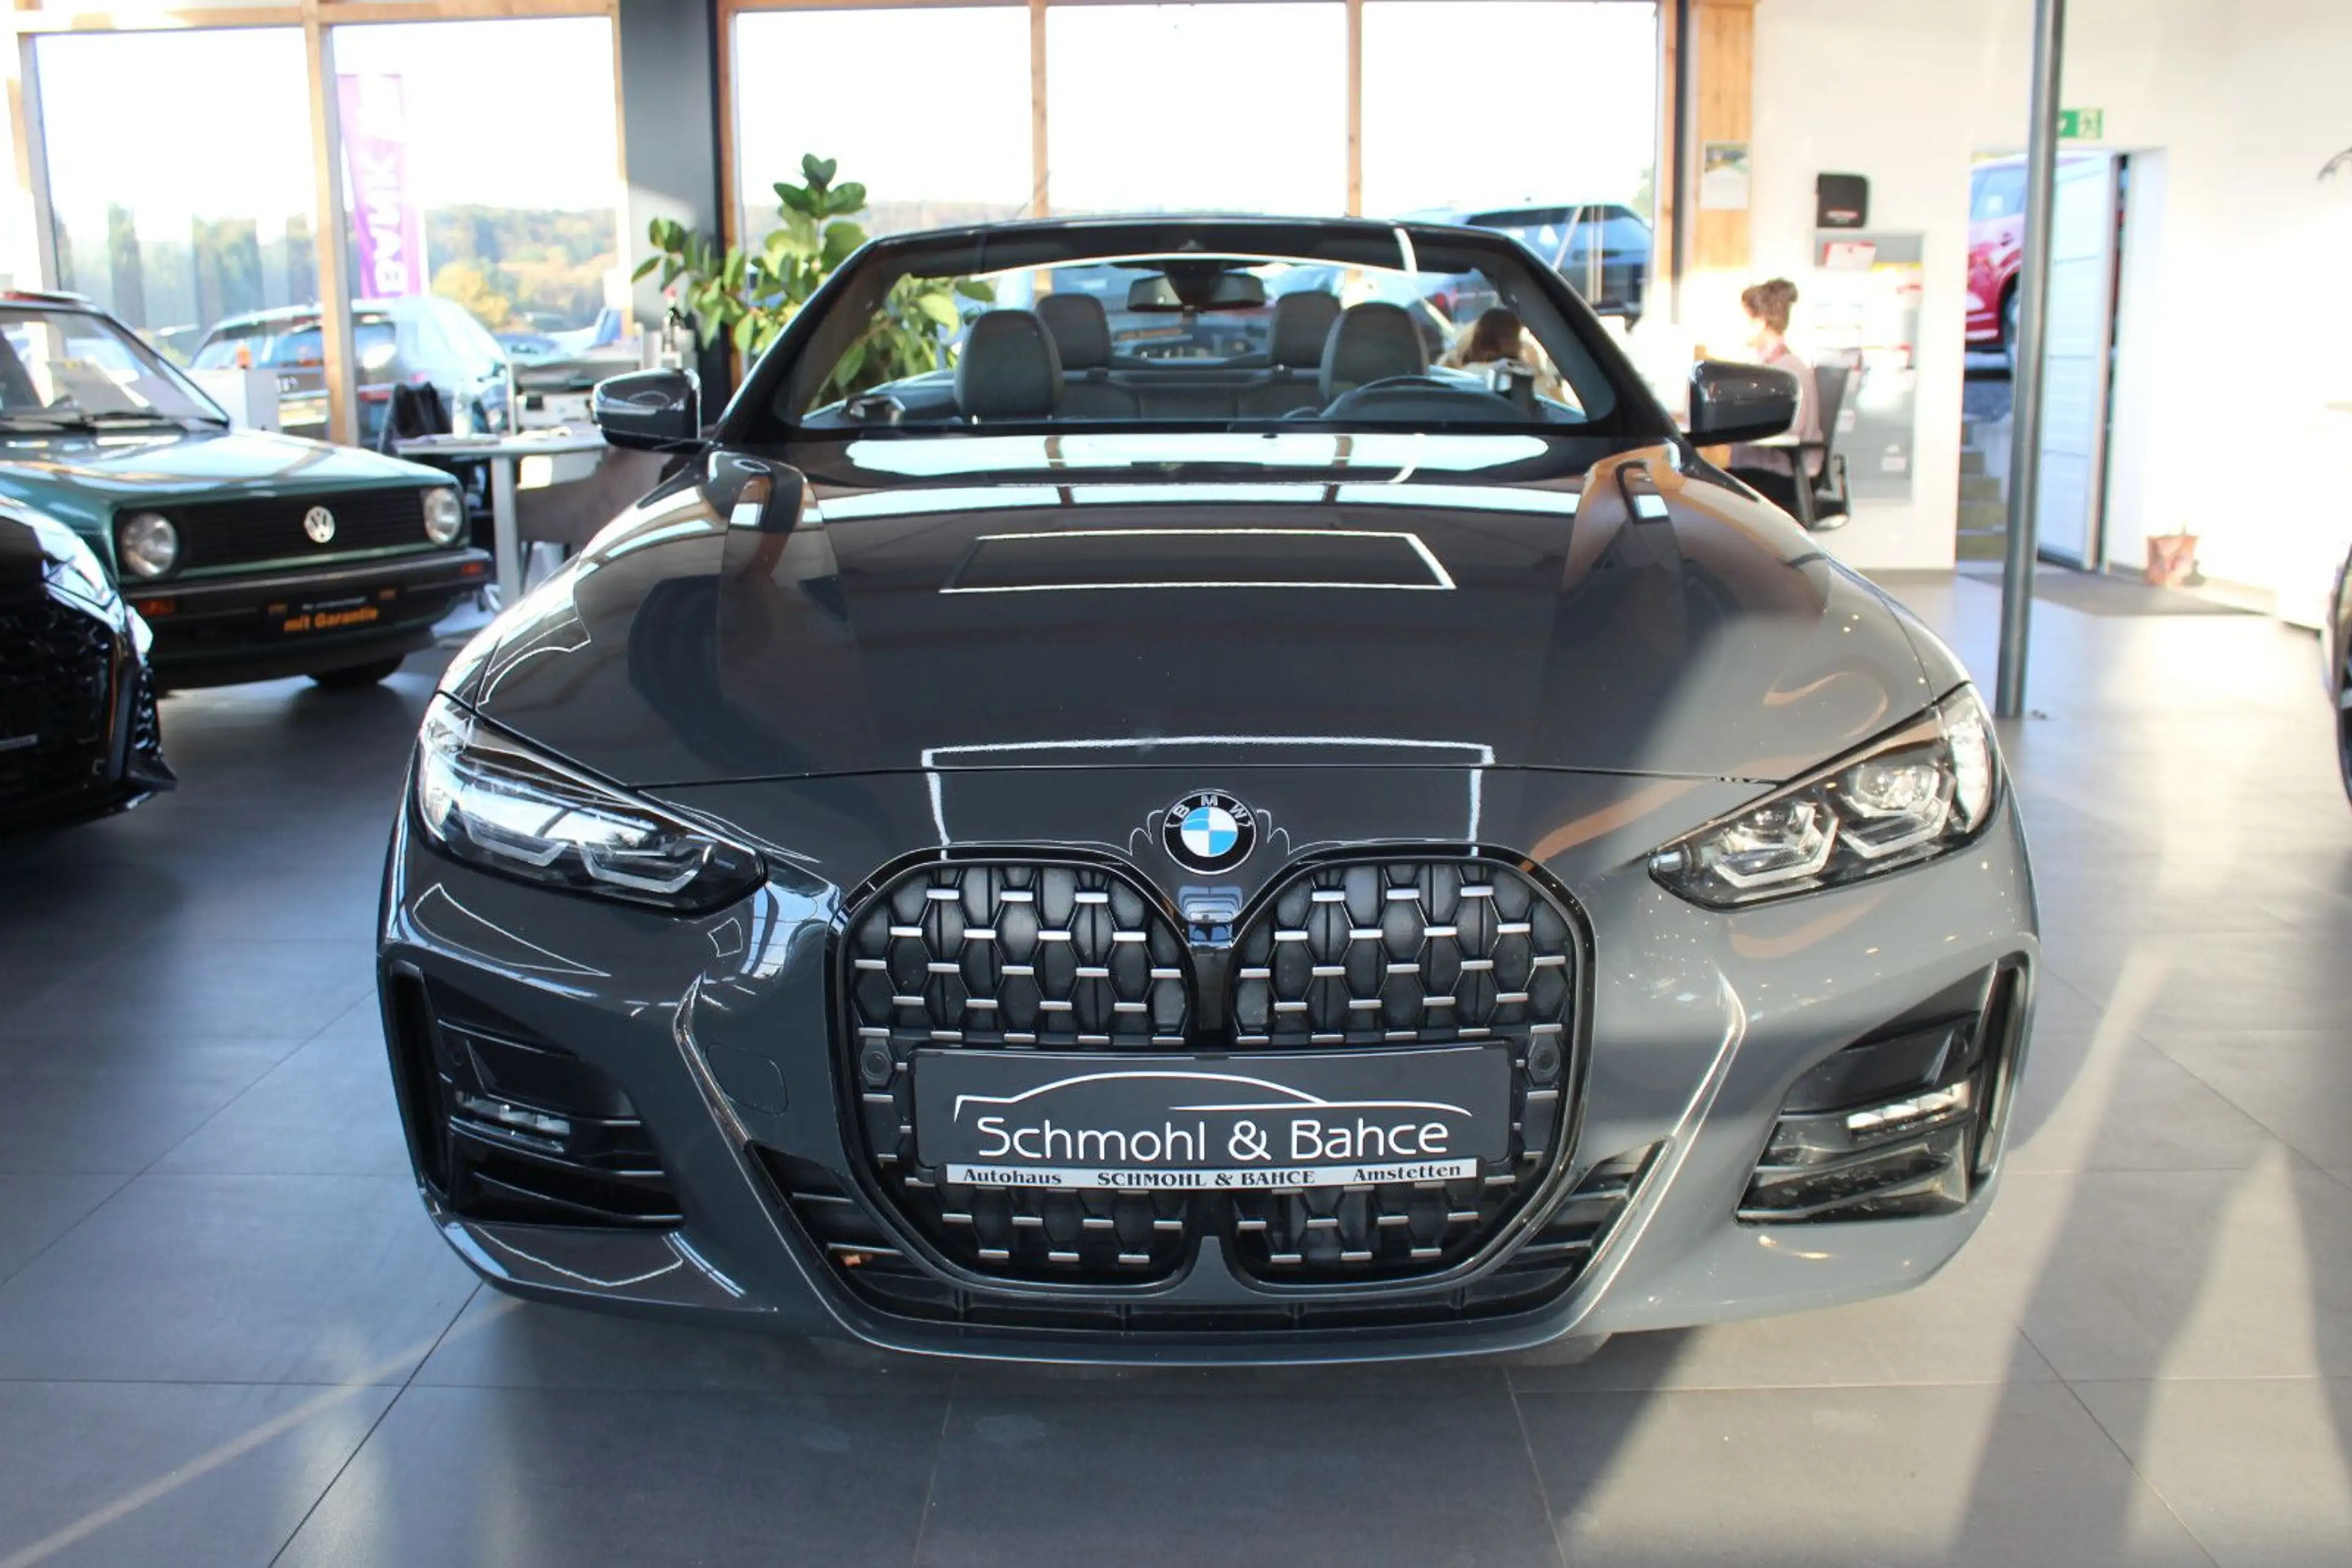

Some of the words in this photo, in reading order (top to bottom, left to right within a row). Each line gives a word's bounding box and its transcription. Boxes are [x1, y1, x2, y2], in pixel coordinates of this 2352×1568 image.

[1173, 795, 1247, 819] BMW
[977, 1116, 1205, 1161] Schmohl
[1227, 1119, 1272, 1161] &
[1290, 1117, 1450, 1160] Bahce
[963, 1167, 1062, 1185] Autohaus
[1097, 1172, 1207, 1187] SCHMOHL
[1214, 1172, 1232, 1186] &
[1241, 1170, 1316, 1186] BAHCE
[1352, 1165, 1461, 1182] Amstetten
